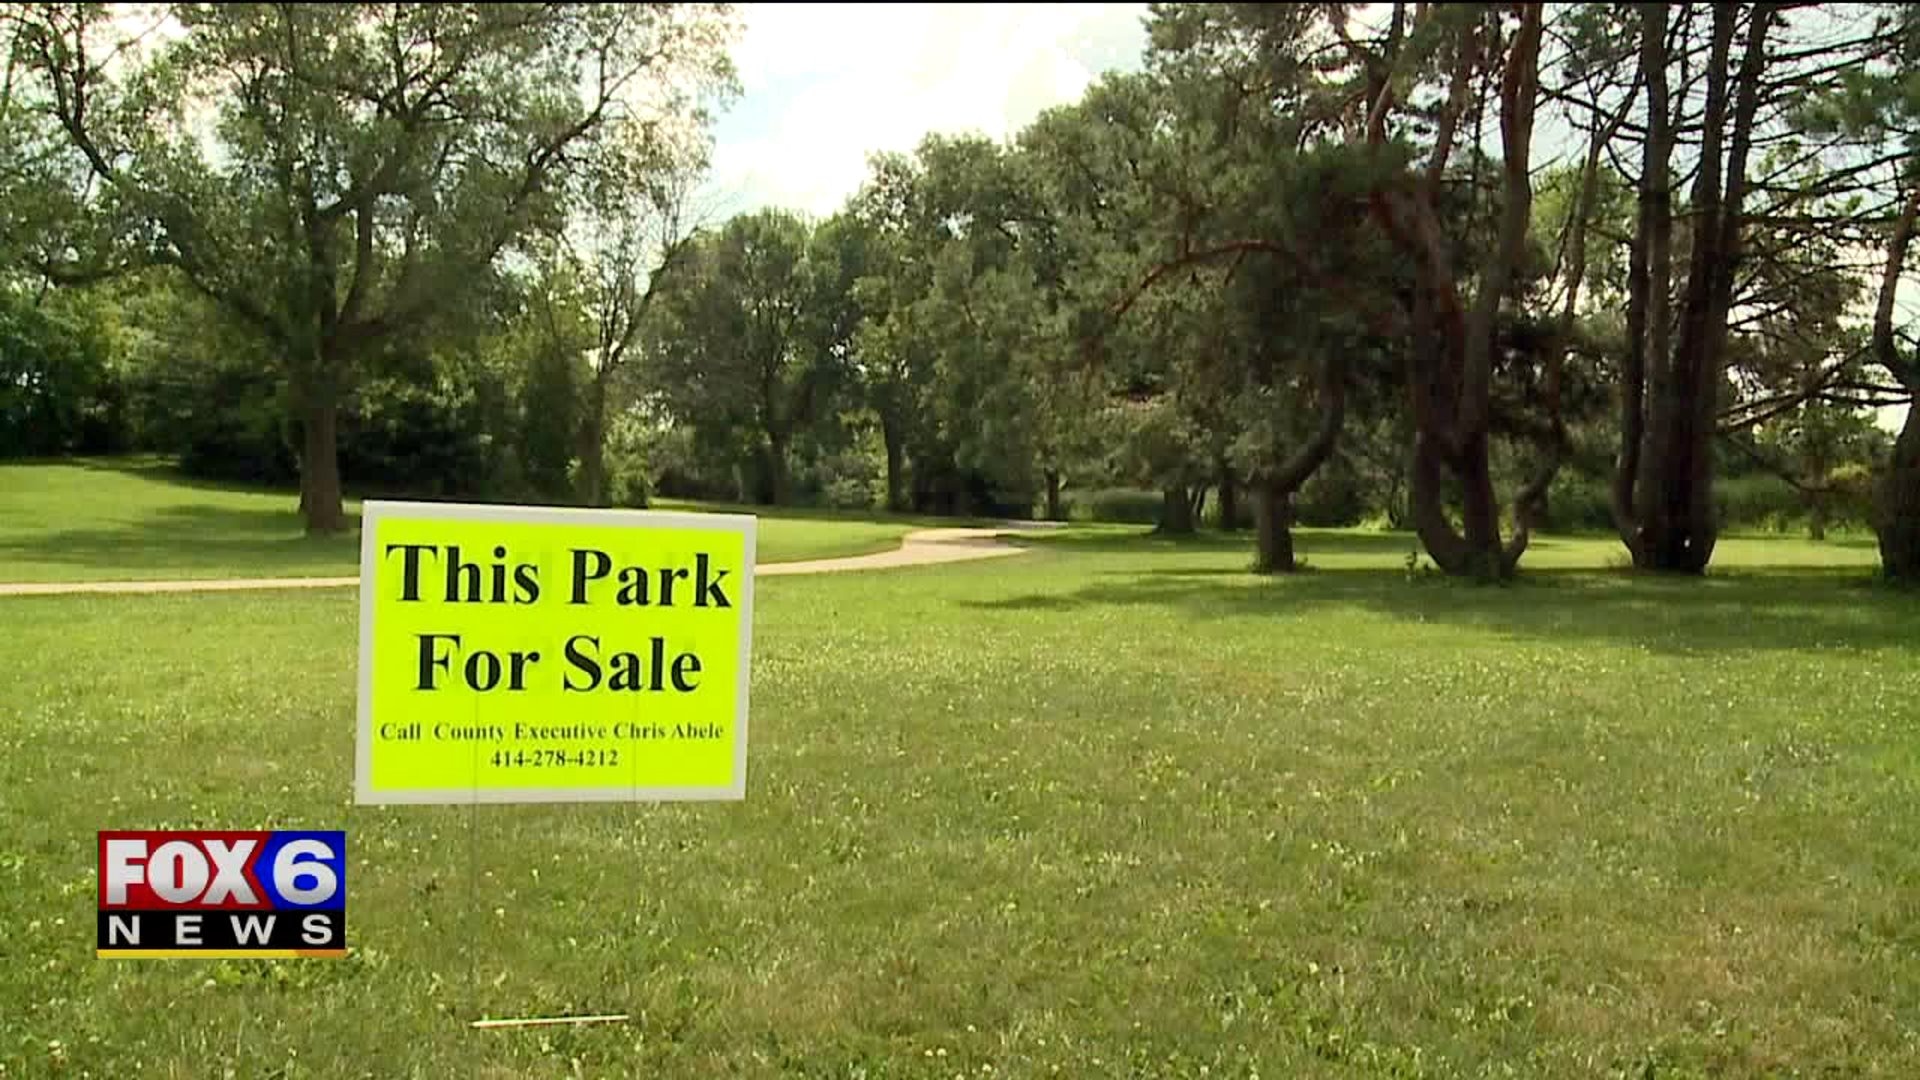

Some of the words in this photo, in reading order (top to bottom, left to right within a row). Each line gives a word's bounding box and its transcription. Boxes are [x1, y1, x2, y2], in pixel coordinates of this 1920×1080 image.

[385, 544, 540, 605] This
[568, 549, 732, 608] Park
[414, 634, 540, 692] For
[563, 635, 702, 693] Sale
[380, 722, 422, 741] Call
[434, 722, 505, 745] County
[514, 722, 607, 741] Executive
[613, 722, 666, 740] Chris
[672, 722, 724, 740] Abele
[491, 749, 619, 768] 414-278-4212
